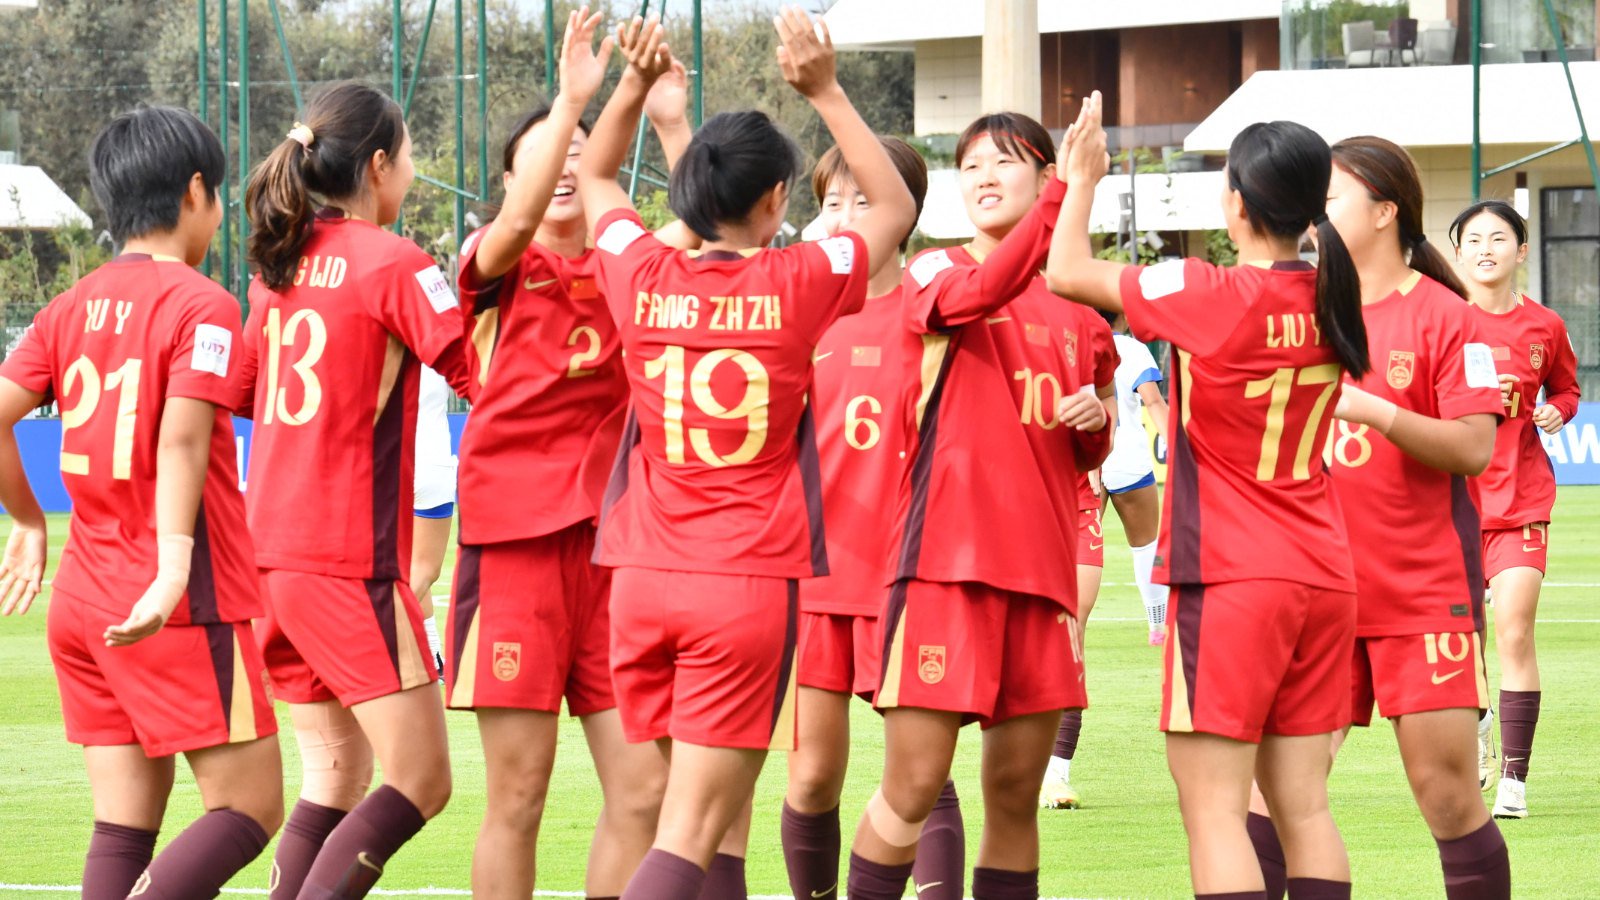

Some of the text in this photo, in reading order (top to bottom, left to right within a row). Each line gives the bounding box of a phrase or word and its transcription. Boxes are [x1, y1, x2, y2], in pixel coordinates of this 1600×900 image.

[114, 300, 133, 334] Y
[635, 291, 699, 329] FANG
[1266, 313, 1304, 348] LIU
[263, 308, 327, 426] 13
[566, 326, 601, 378] 2
[60, 354, 142, 480] 21
[645, 345, 770, 468] 19
[844, 395, 882, 450] 6
[1013, 367, 1064, 430] 10
[1244, 363, 1340, 481] 17
